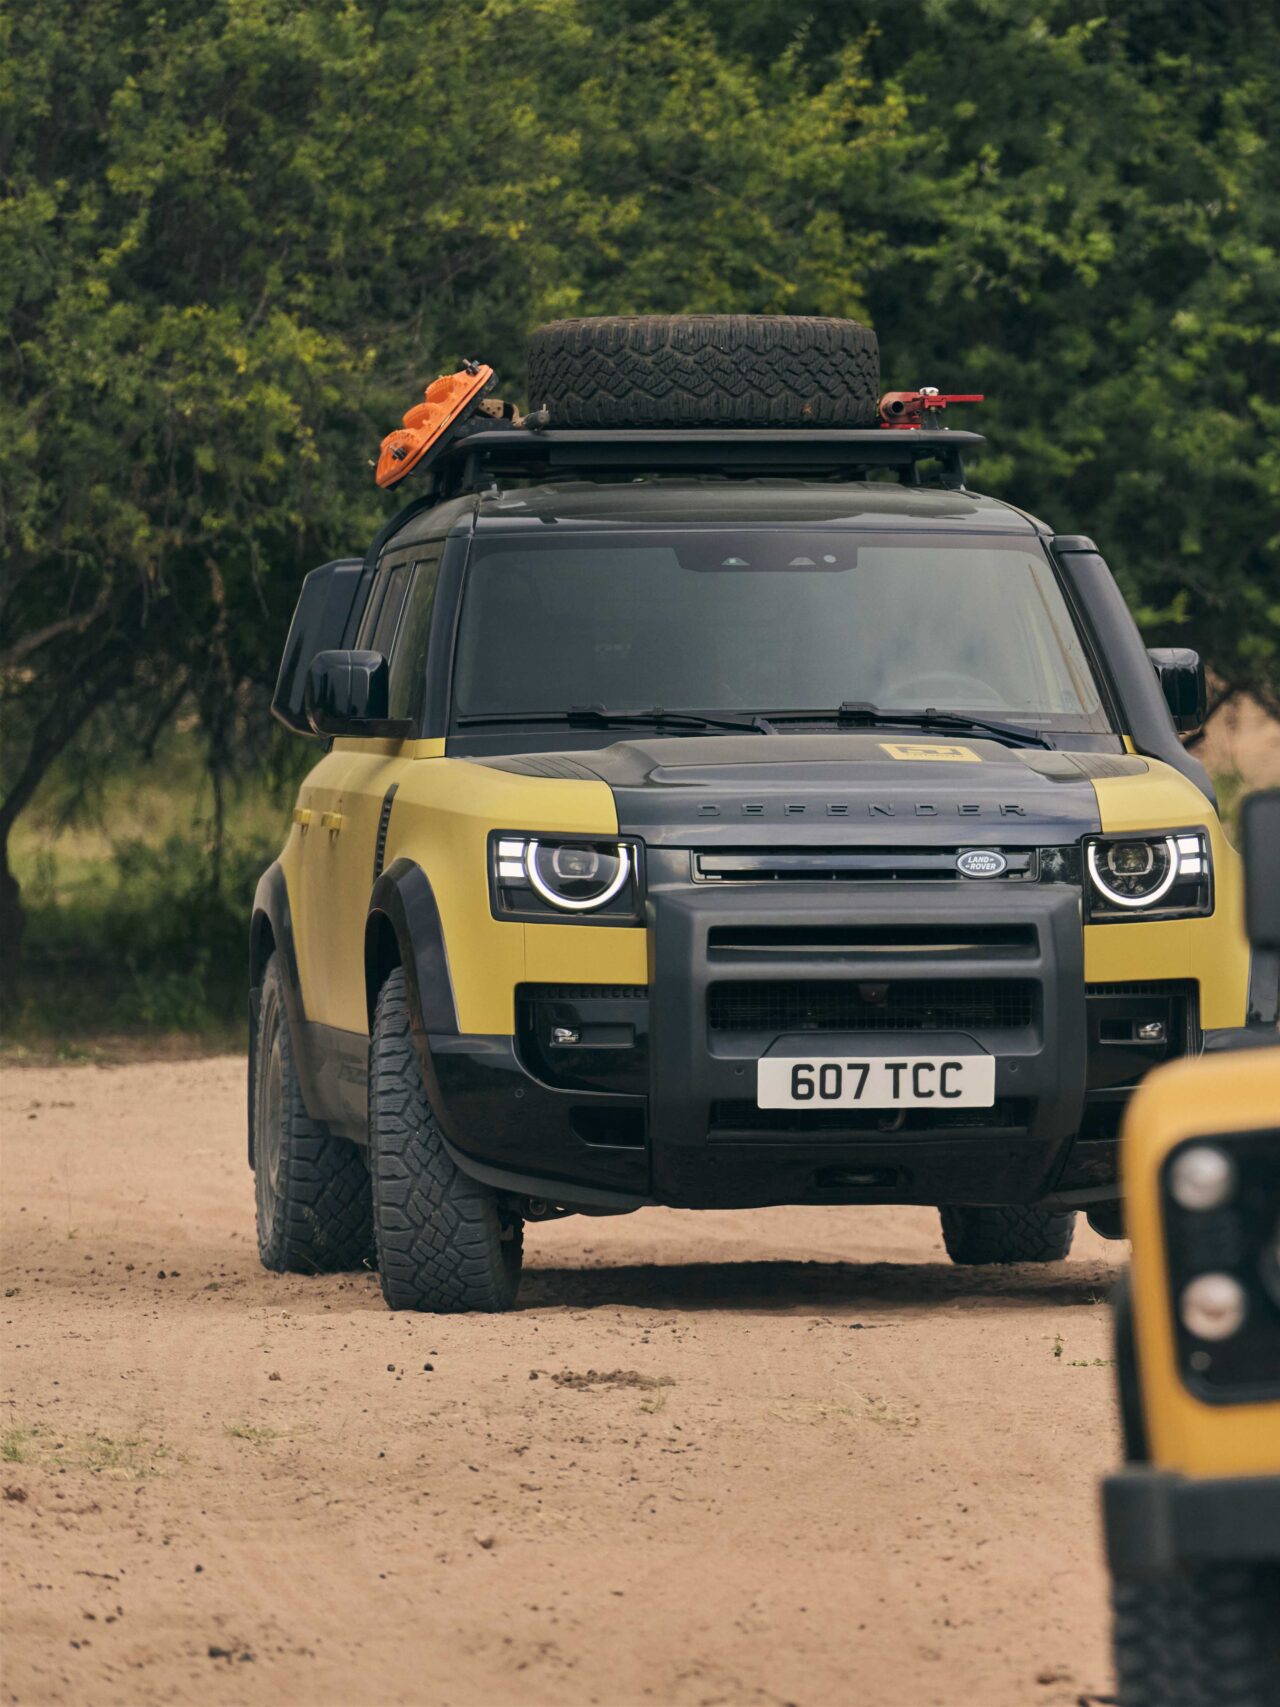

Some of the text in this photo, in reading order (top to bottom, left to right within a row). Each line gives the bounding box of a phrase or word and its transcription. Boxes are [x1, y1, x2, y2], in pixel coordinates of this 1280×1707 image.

[697, 803, 1026, 817] DEFENDER
[790, 1061, 963, 1100] 607 TCC
